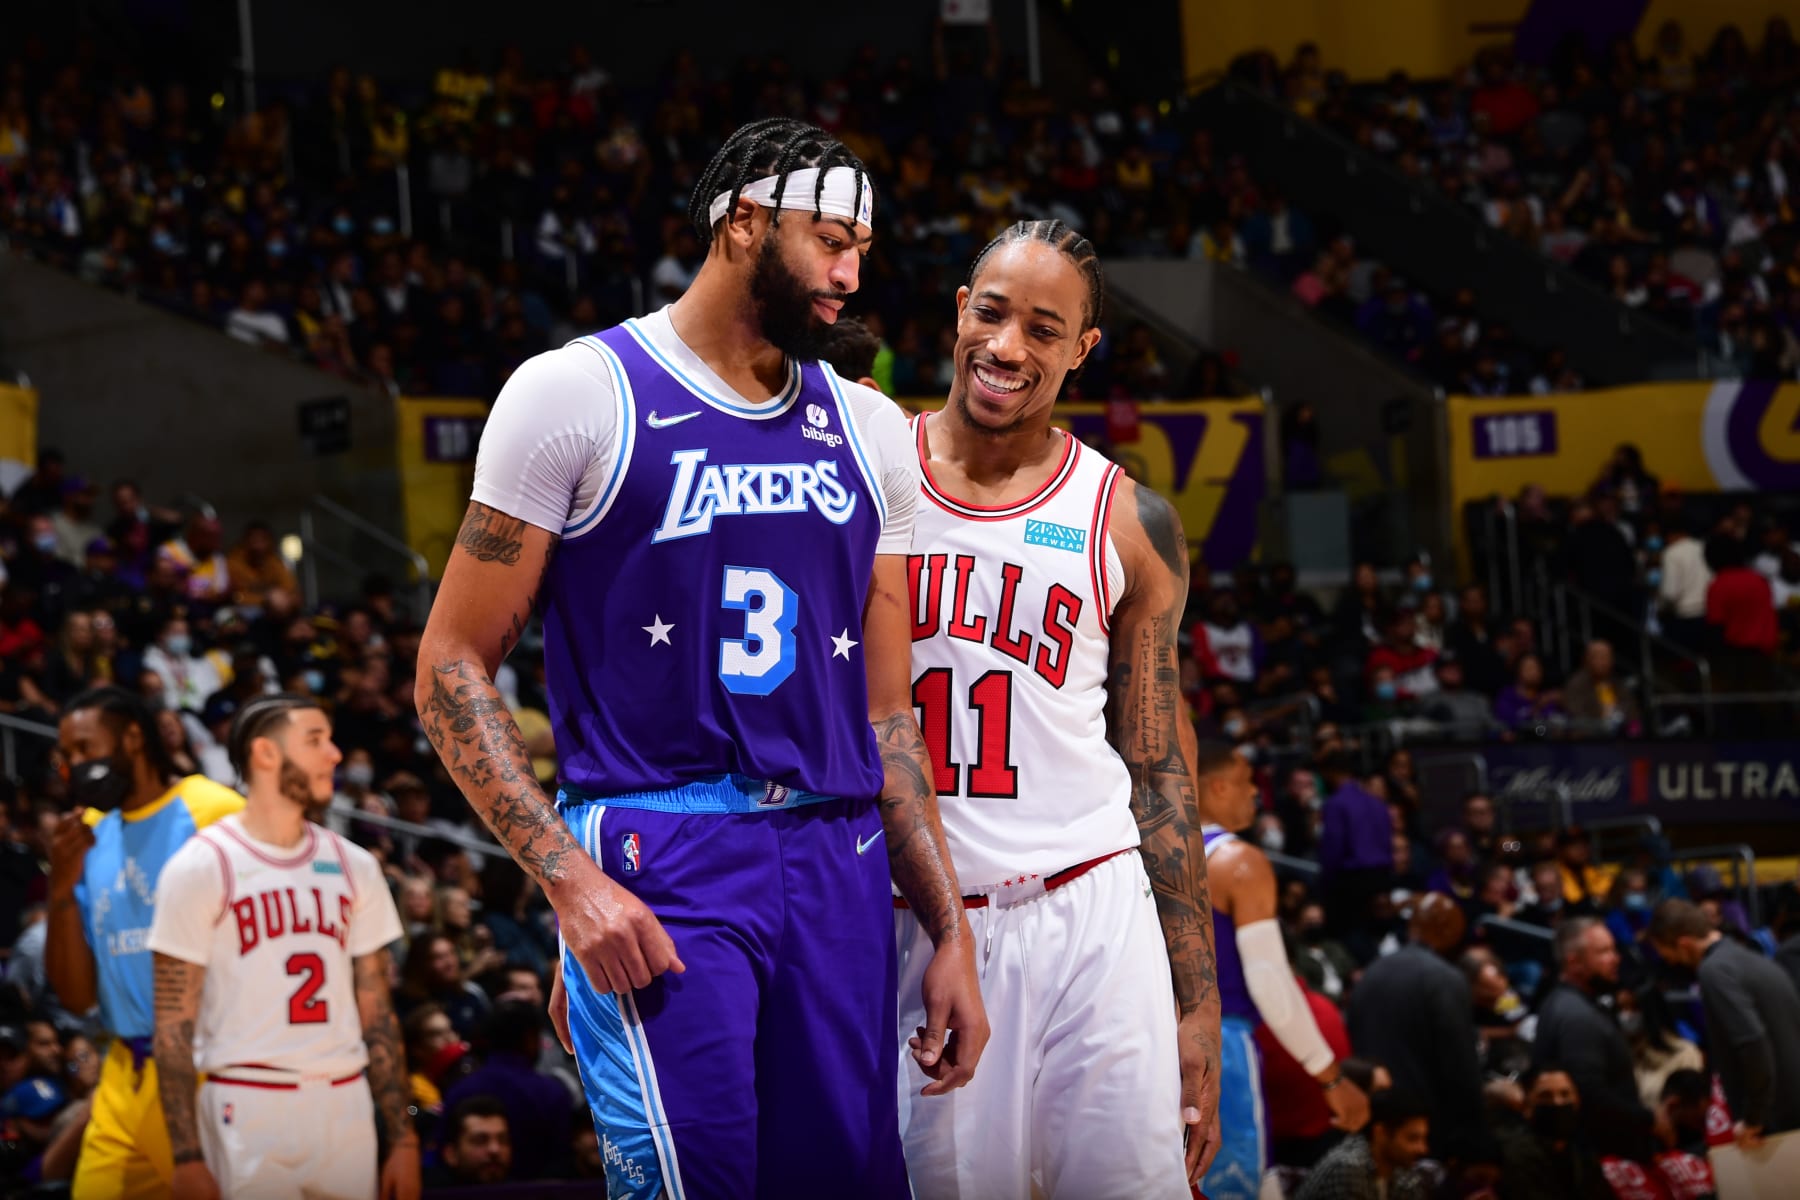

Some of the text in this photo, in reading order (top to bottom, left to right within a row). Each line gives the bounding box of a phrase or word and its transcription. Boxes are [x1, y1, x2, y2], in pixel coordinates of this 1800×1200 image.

[801, 424, 843, 448] bibigo
[1485, 415, 1542, 455] 105
[651, 448, 857, 544] LAKERS
[1026, 534, 1083, 551] EYEWEAR
[718, 564, 799, 697] 3
[907, 553, 1083, 690] ULLS
[912, 667, 1018, 800] 11
[1657, 761, 1800, 800] ULTRA
[233, 888, 352, 956] BULLS
[285, 952, 329, 1024] 2
